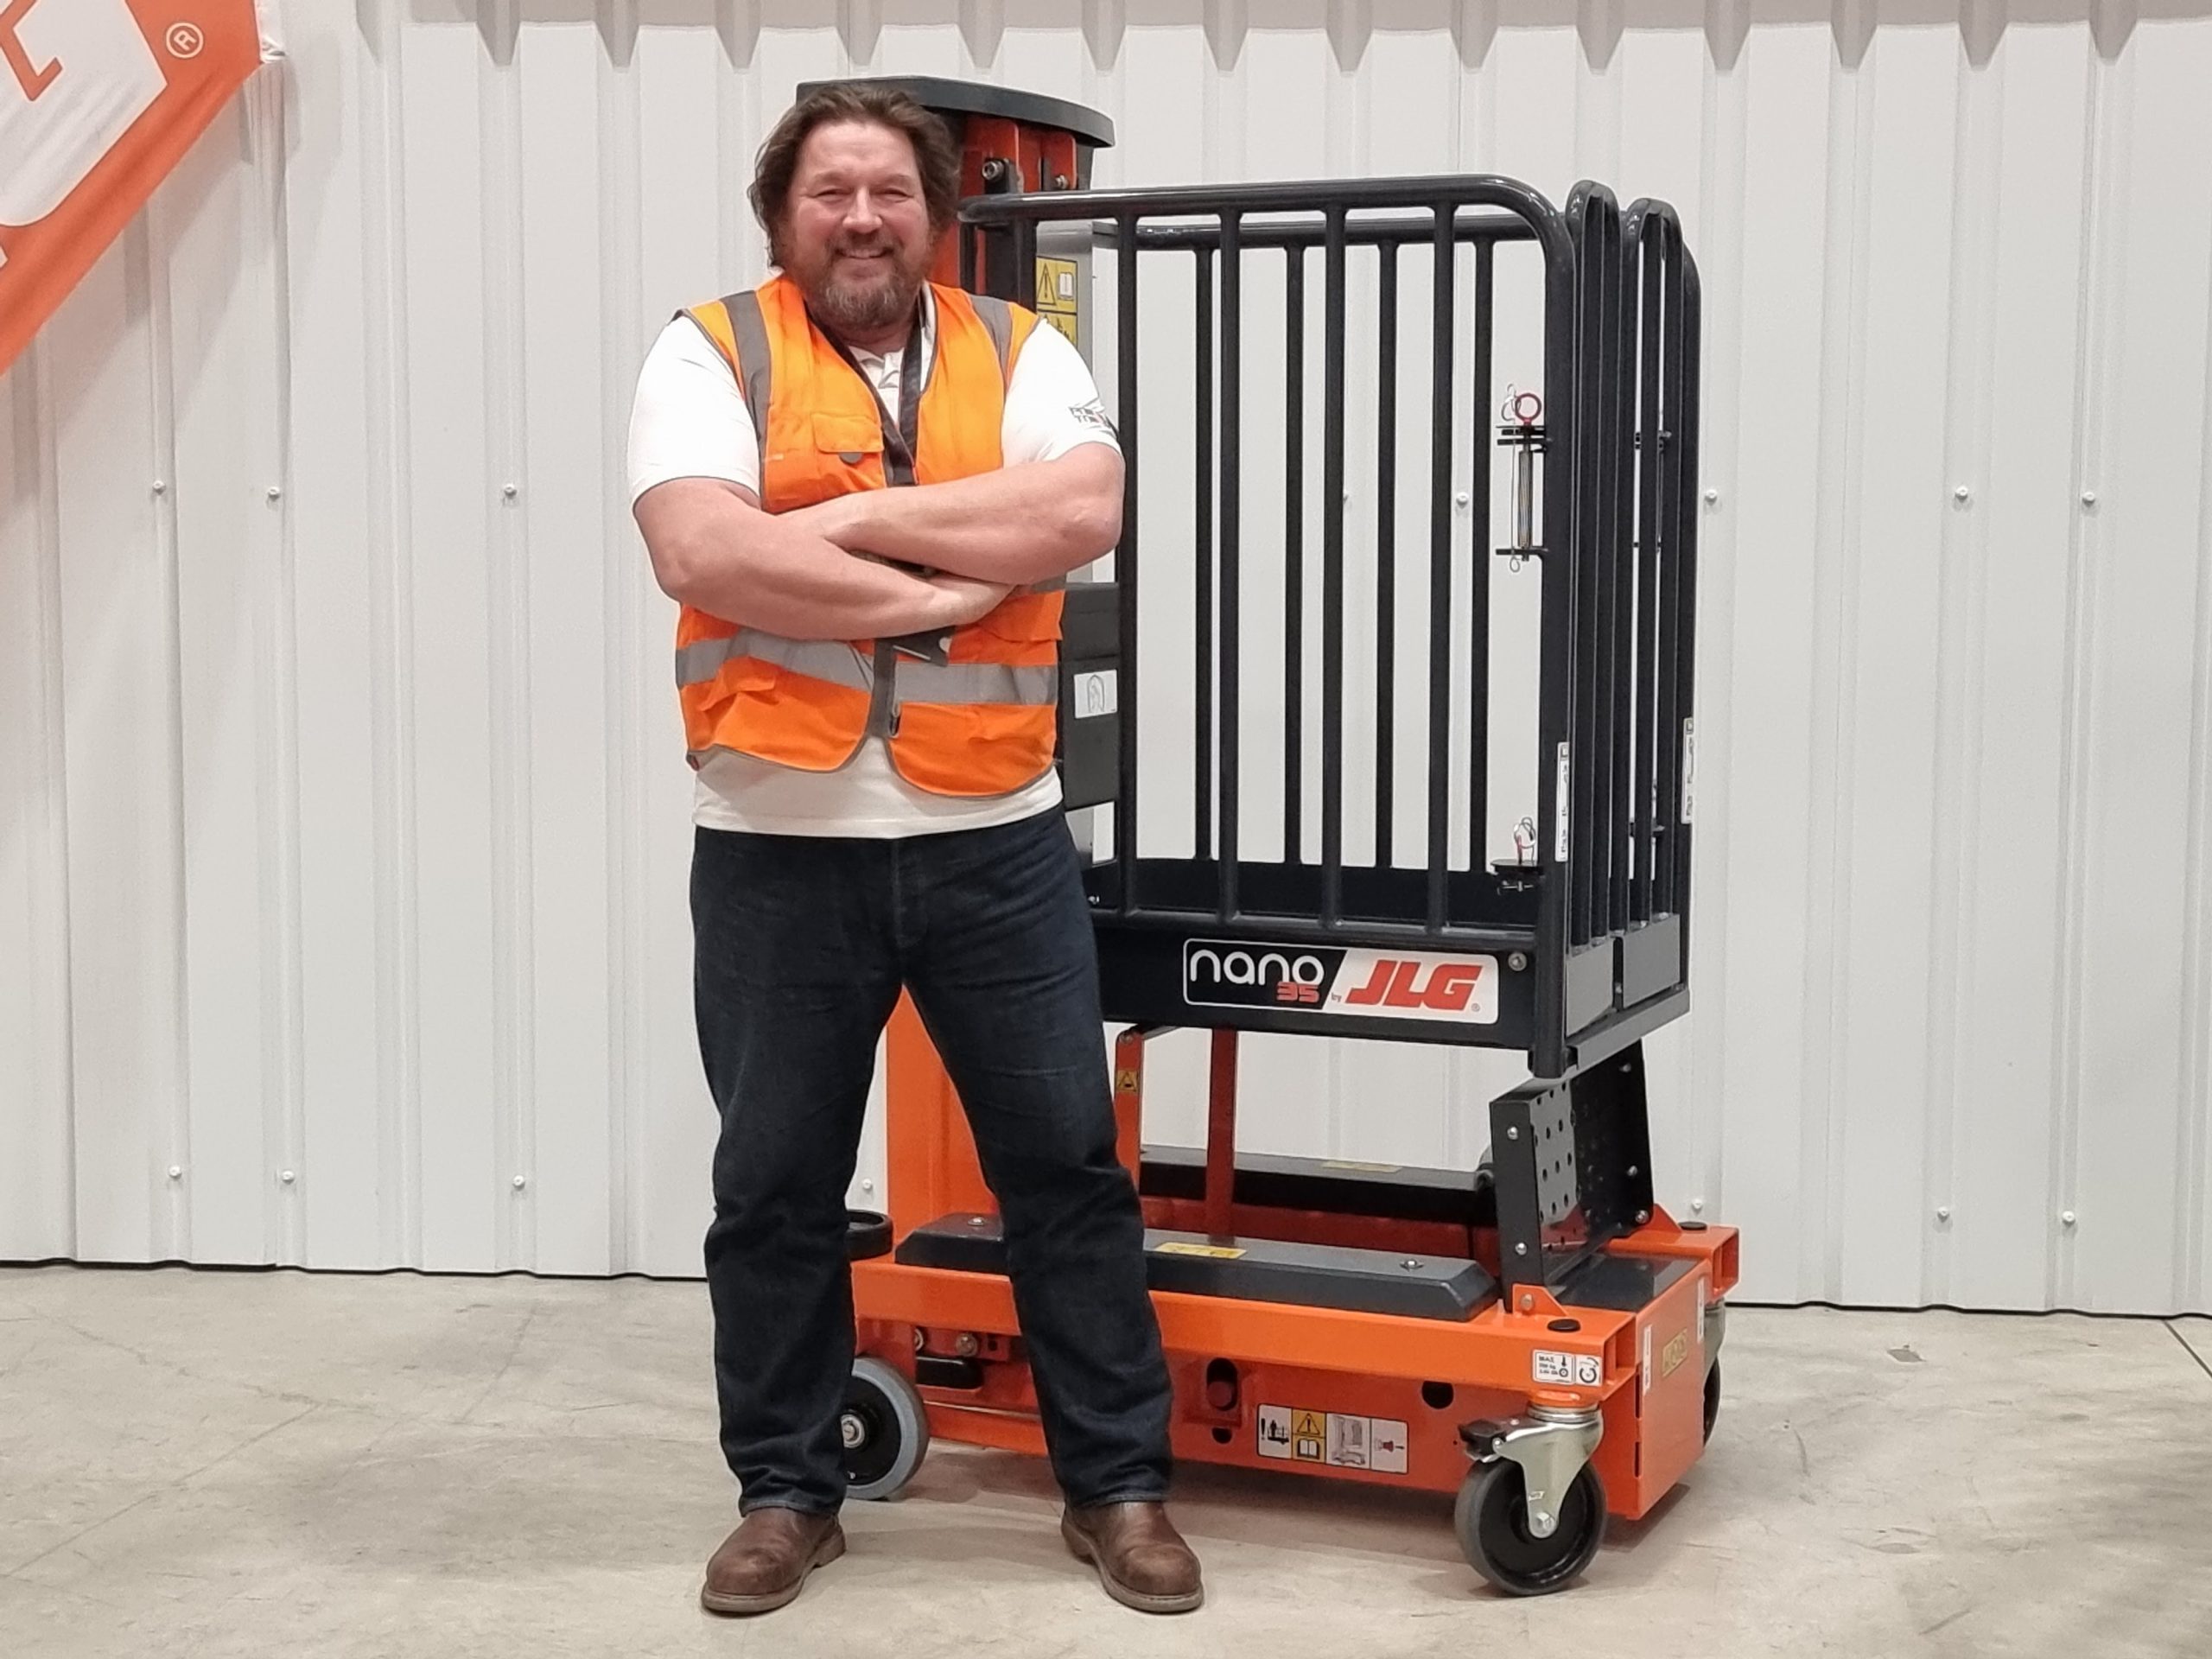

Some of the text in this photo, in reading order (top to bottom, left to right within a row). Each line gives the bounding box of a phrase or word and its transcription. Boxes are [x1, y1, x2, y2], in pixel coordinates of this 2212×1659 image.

[1190, 949, 1325, 986] nano
[1344, 959, 1483, 1012] JLG
[1276, 982, 1320, 1003] 35
